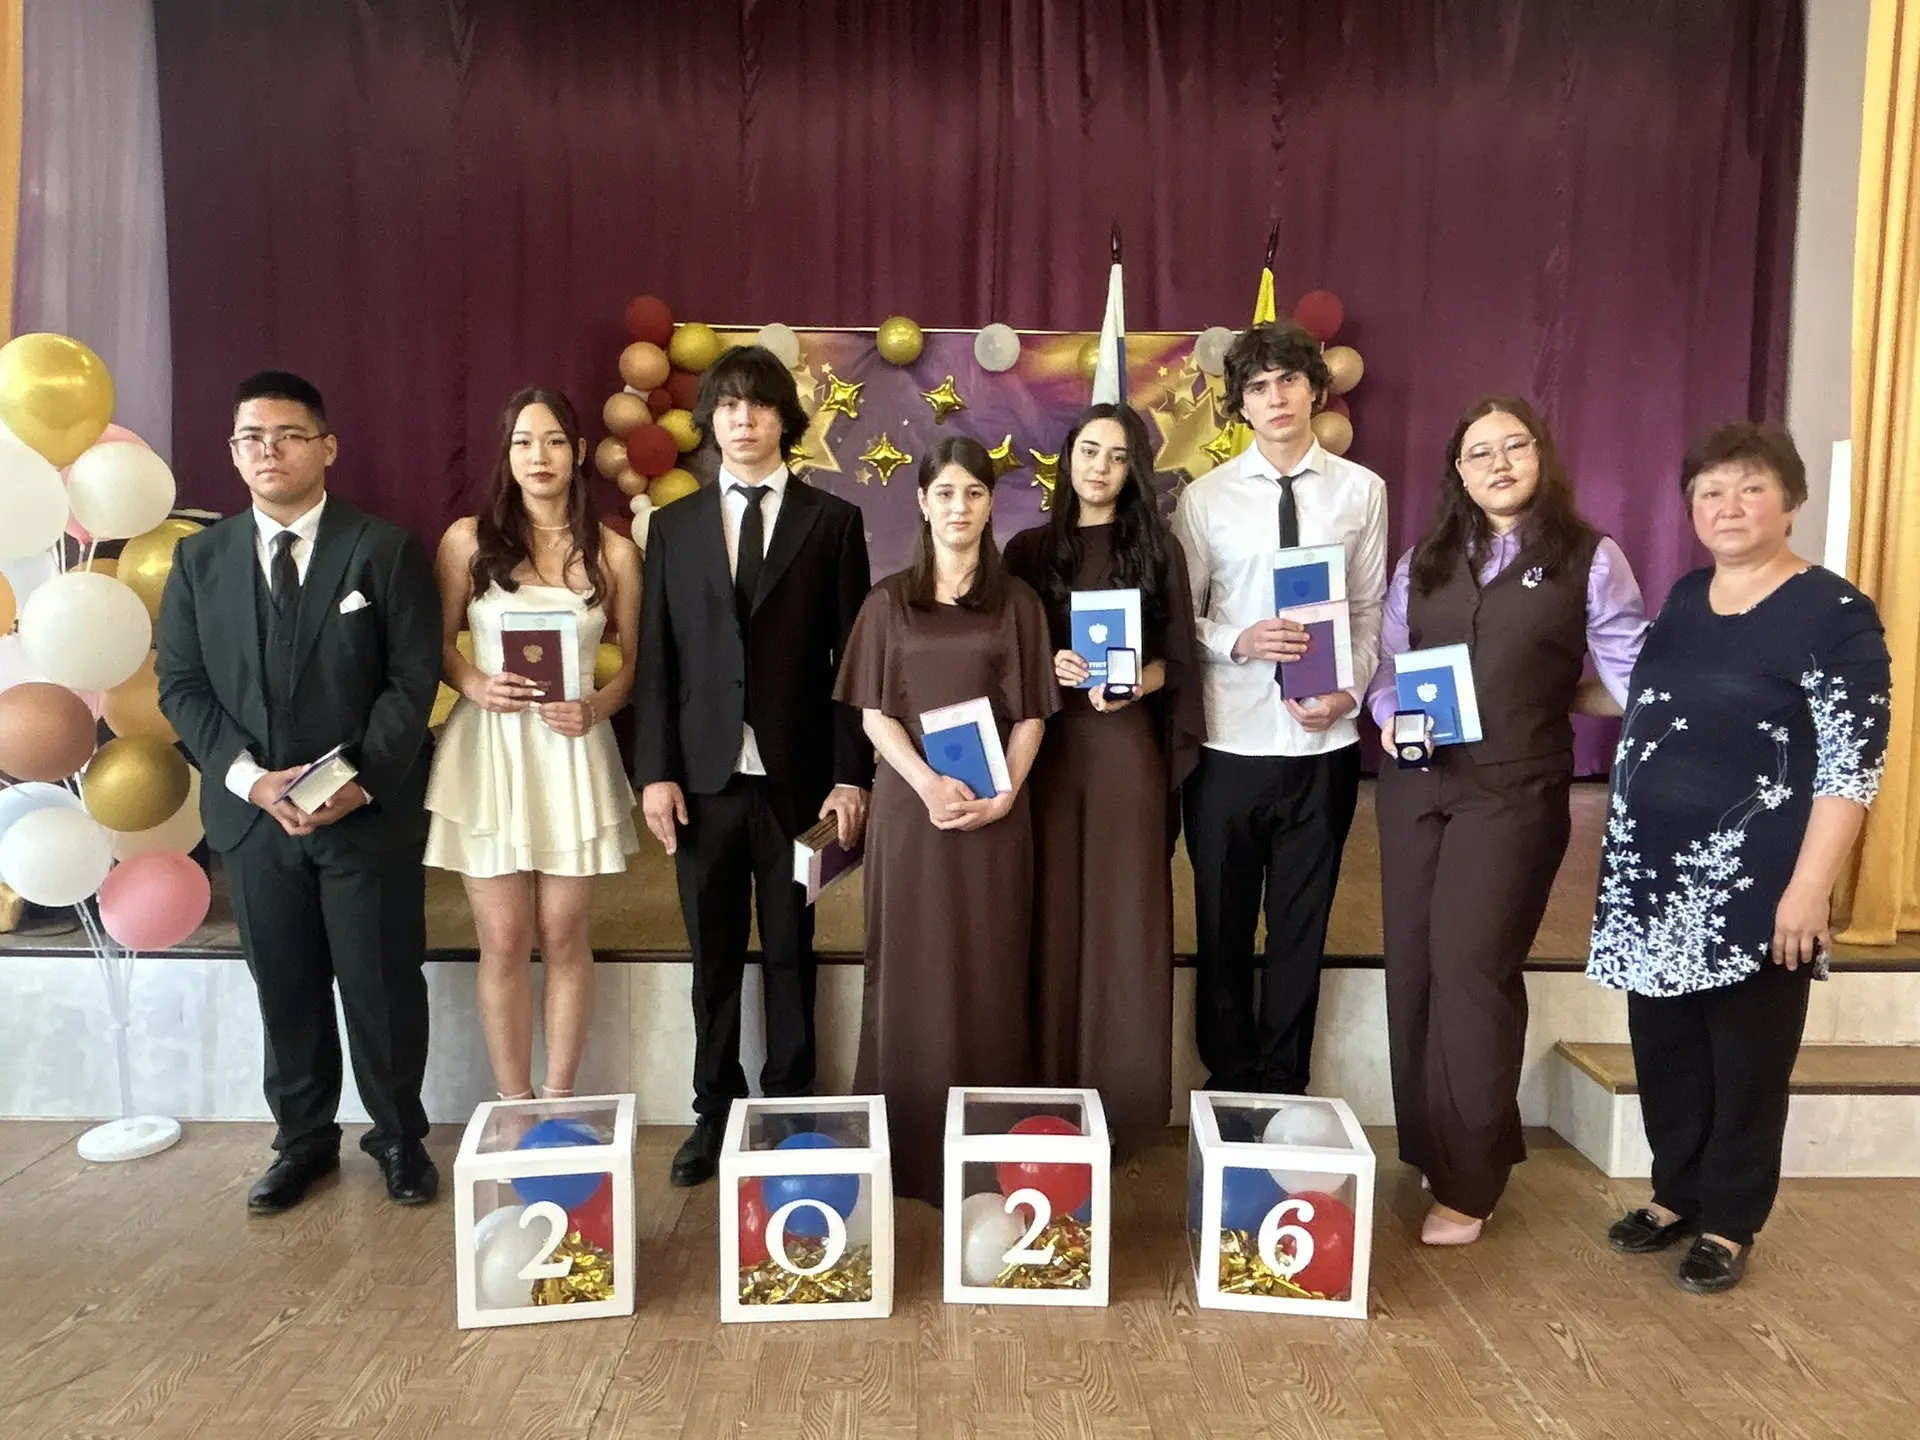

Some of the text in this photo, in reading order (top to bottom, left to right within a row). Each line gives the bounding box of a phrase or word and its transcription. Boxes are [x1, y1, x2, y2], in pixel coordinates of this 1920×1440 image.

[517, 1201, 573, 1279] 2
[1003, 1188, 1056, 1265] 2
[1257, 1199, 1315, 1276] 6
